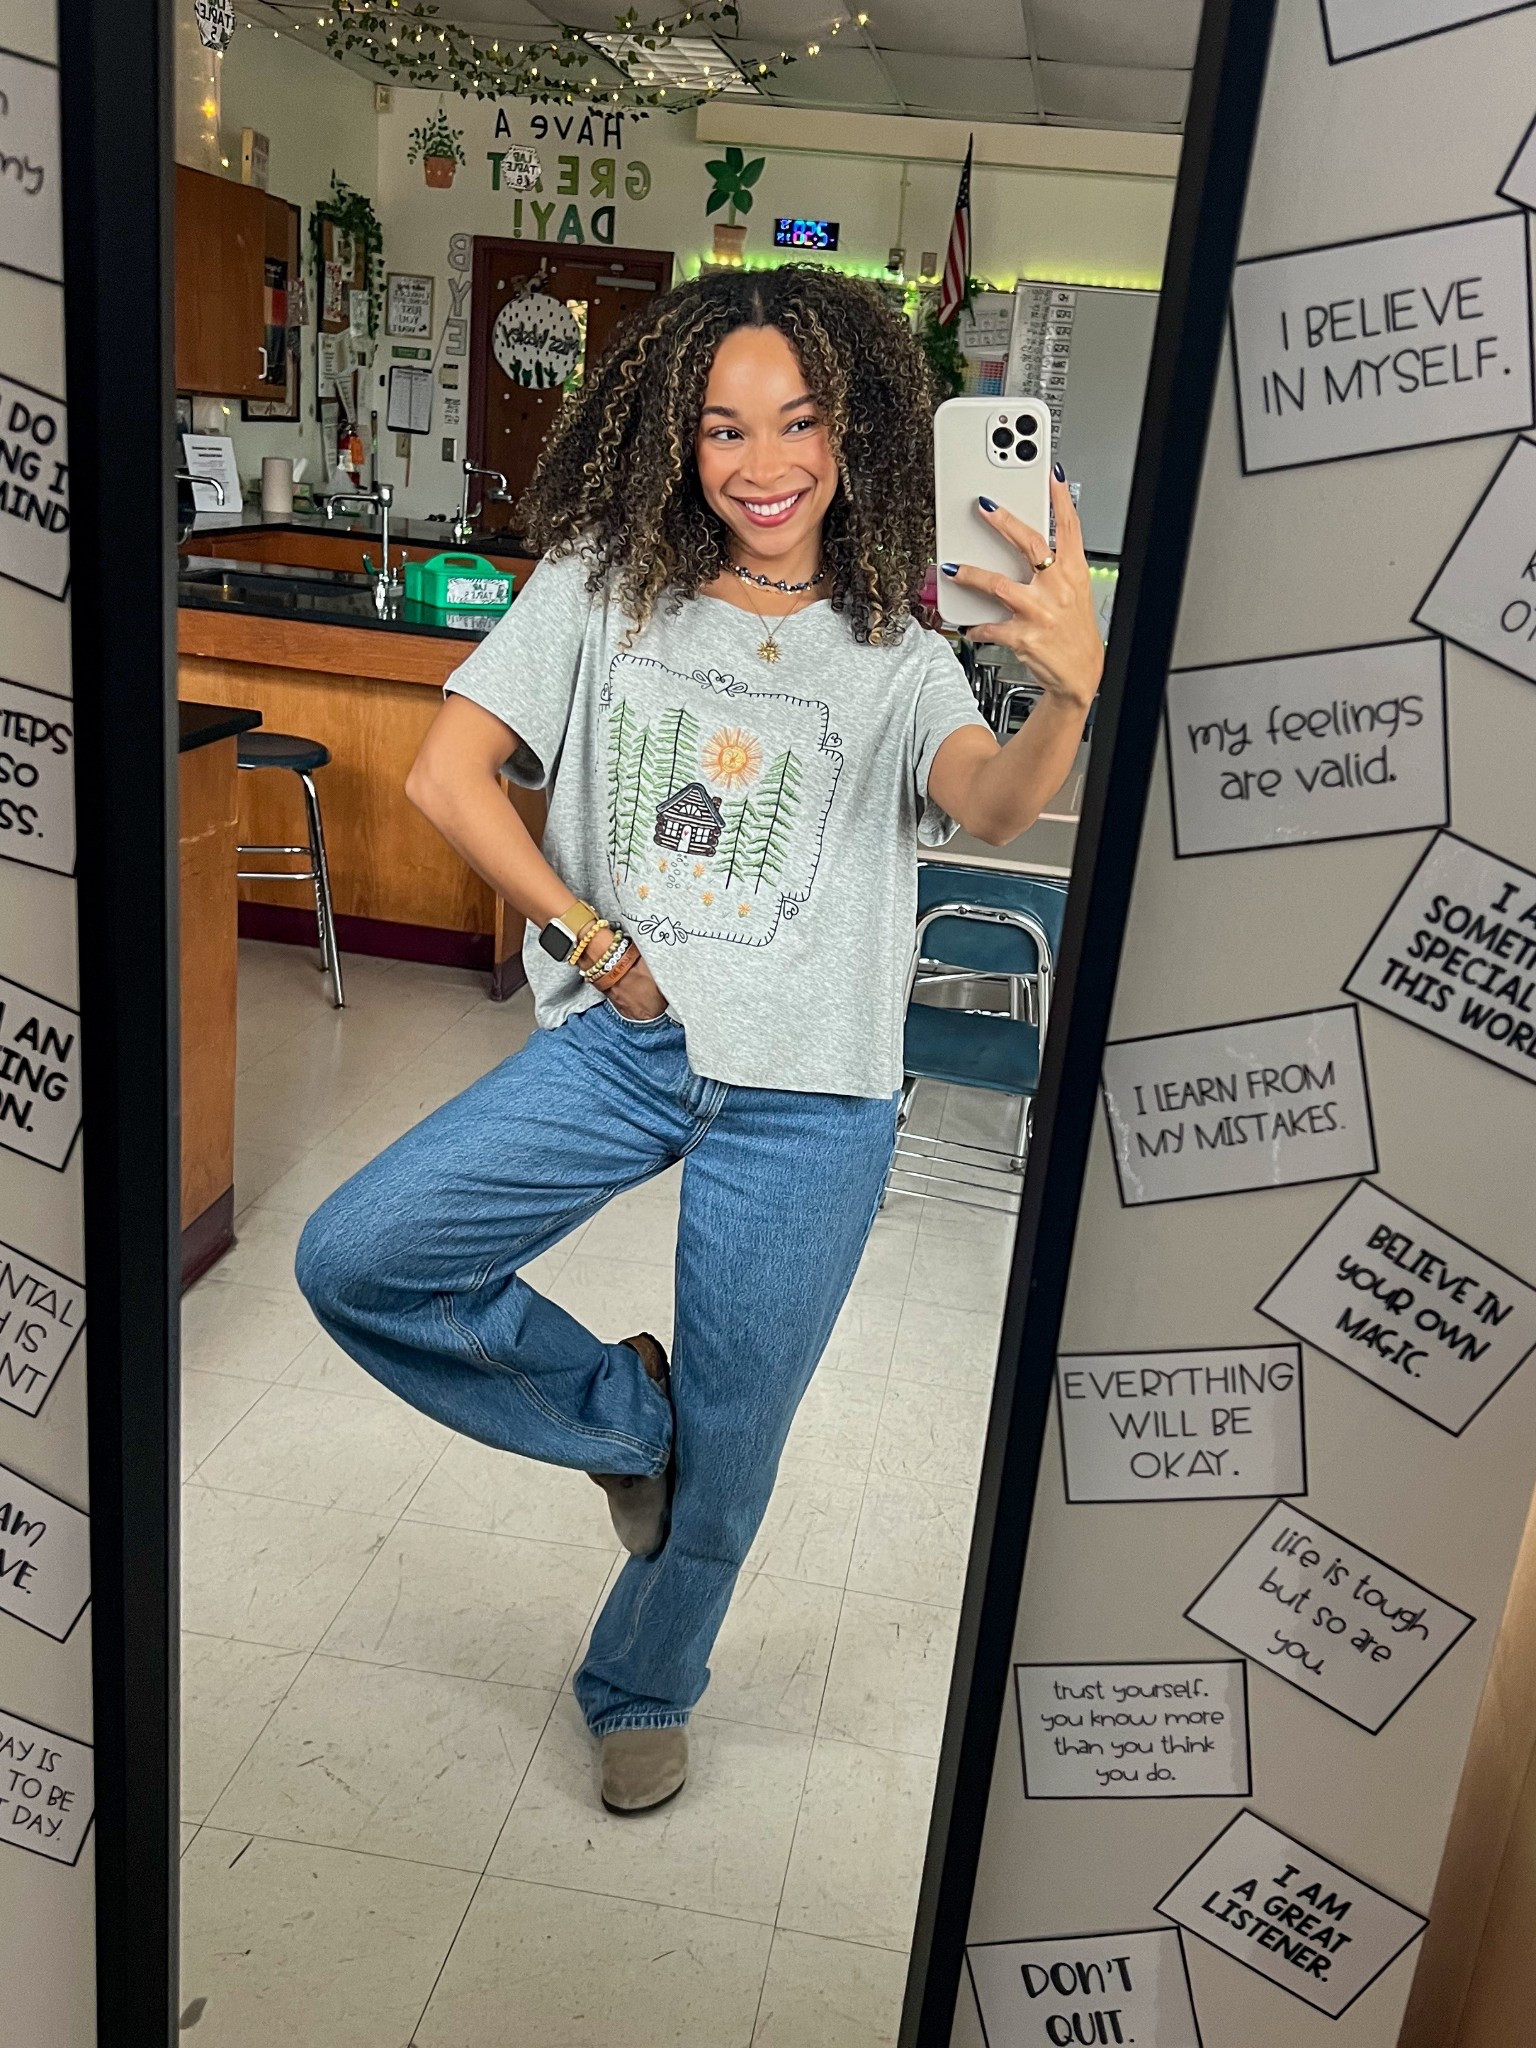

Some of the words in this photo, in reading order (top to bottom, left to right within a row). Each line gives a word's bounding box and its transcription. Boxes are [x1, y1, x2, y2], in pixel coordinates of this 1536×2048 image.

[1281, 311, 1289, 351] I
[1305, 277, 1484, 348] BELIEVE
[1263, 367, 1304, 416] IN
[1324, 336, 1511, 405] MYSELF.
[9, 402, 57, 446] DO
[48, 461, 68, 495] I
[0, 480, 69, 533] IND
[1500, 600, 1536, 641] O
[0, 709, 73, 755] TEPS
[1188, 718, 1253, 756] my
[1266, 695, 1423, 745] feelings
[1220, 769, 1282, 800] are
[1295, 745, 1397, 793] valid.
[1490, 882, 1521, 914] I
[1380, 958, 1456, 1012] THIS
[1406, 930, 1536, 1013] SPECIAL
[14, 1017, 74, 1063] AN
[0, 1087, 34, 1132] N.
[1133, 1086, 1147, 1115] I
[1154, 1074, 1237, 1112] LEARN
[1246, 1061, 1335, 1099] FROM
[1136, 1123, 1184, 1158] MY
[1194, 1102, 1346, 1149] MISTAKES.
[0, 1261, 73, 1327] NTAL
[1366, 1224, 1480, 1304] BELIEVE
[1472, 1291, 1514, 1326] IN
[14, 1320, 47, 1353] IS
[1335, 1307, 1429, 1377] MAGIC.
[1414, 1309, 1491, 1362] OWN
[1064, 1362, 1294, 1399] EVERYTHING
[1109, 1410, 1197, 1439] WILL
[1211, 1407, 1252, 1436] BE
[1130, 1449, 1239, 1479] OKAY.
[1271, 1527, 1320, 1568] life
[1323, 1558, 1349, 1586] is
[1353, 1575, 1429, 1640] tough
[1259, 1566, 1311, 1614] but
[1312, 1607, 1346, 1634] so
[1350, 1628, 1391, 1662] are
[1267, 1630, 1324, 1675] you.
[1053, 1681, 1105, 1700] trust
[1113, 1678, 1208, 1703] yourself.
[1041, 1714, 1083, 1731] you
[1091, 1709, 1157, 1727] know
[1165, 1711, 1224, 1725] more
[0, 1731, 35, 1761] AY
[37, 1747, 62, 1772] IS
[1054, 1737, 1103, 1755] than
[1111, 1741, 1153, 1759] you
[1161, 1735, 1214, 1754] think
[9, 1768, 42, 1798] TO
[47, 1784, 75, 1812] BE
[1096, 1769, 1138, 1786] you
[1146, 1762, 1176, 1781] do.
[12, 1805, 63, 1841] DAY.
[1272, 1864, 1301, 1888] I
[1296, 1883, 1352, 1921] AM
[1200, 1891, 1332, 1982] LISTENER.
[1232, 1879, 1258, 1901] A
[1263, 1896, 1353, 1953] GREAT
[1046, 2009, 1134, 2047] QUIT.
